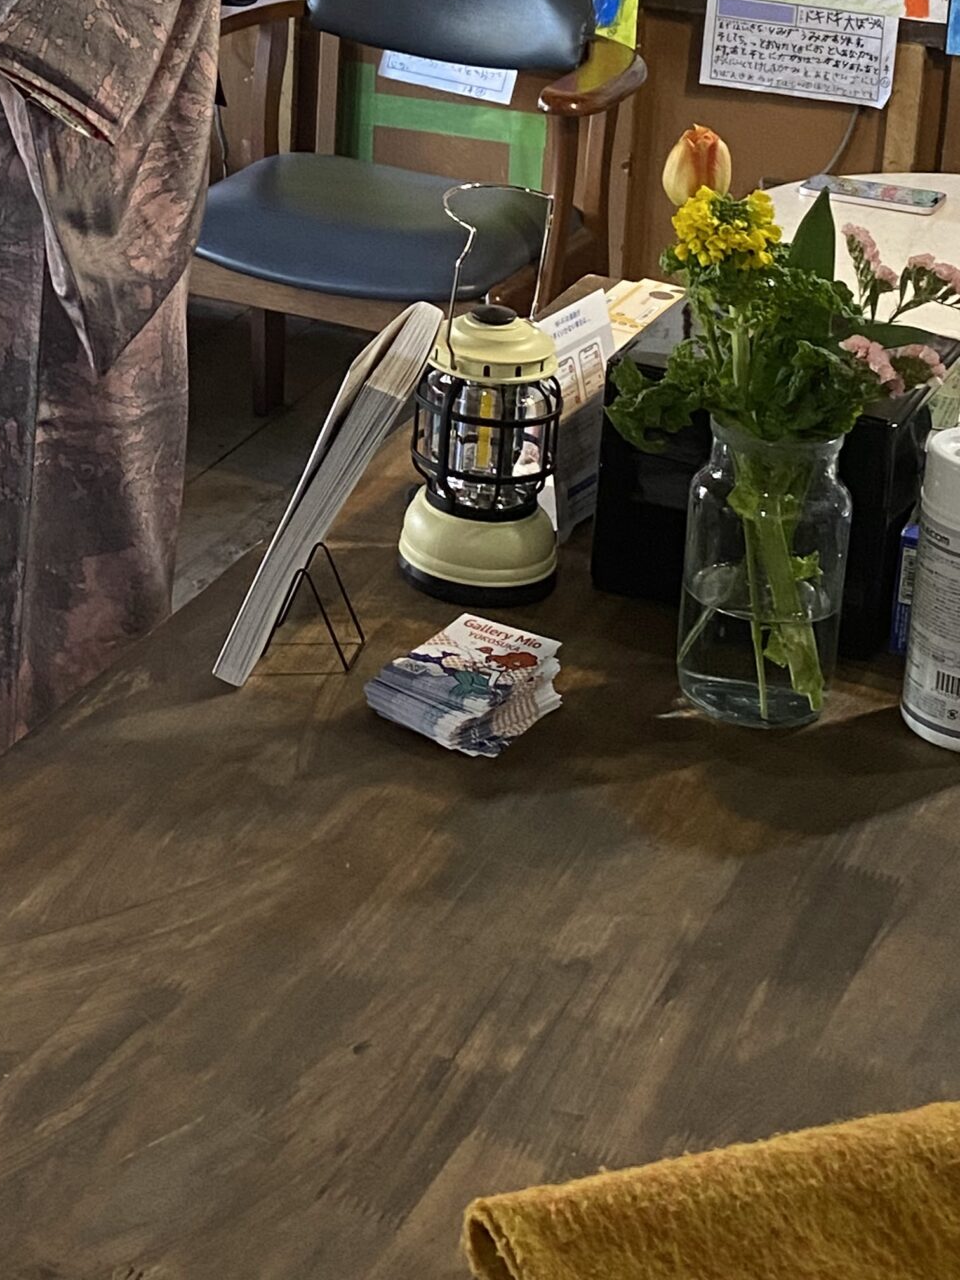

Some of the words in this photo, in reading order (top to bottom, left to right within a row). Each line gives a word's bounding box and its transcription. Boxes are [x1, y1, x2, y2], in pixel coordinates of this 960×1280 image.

[464, 619, 514, 641] Gallery
[515, 635, 542, 649] Mio
[468, 631, 520, 651] YOKOSUKA
